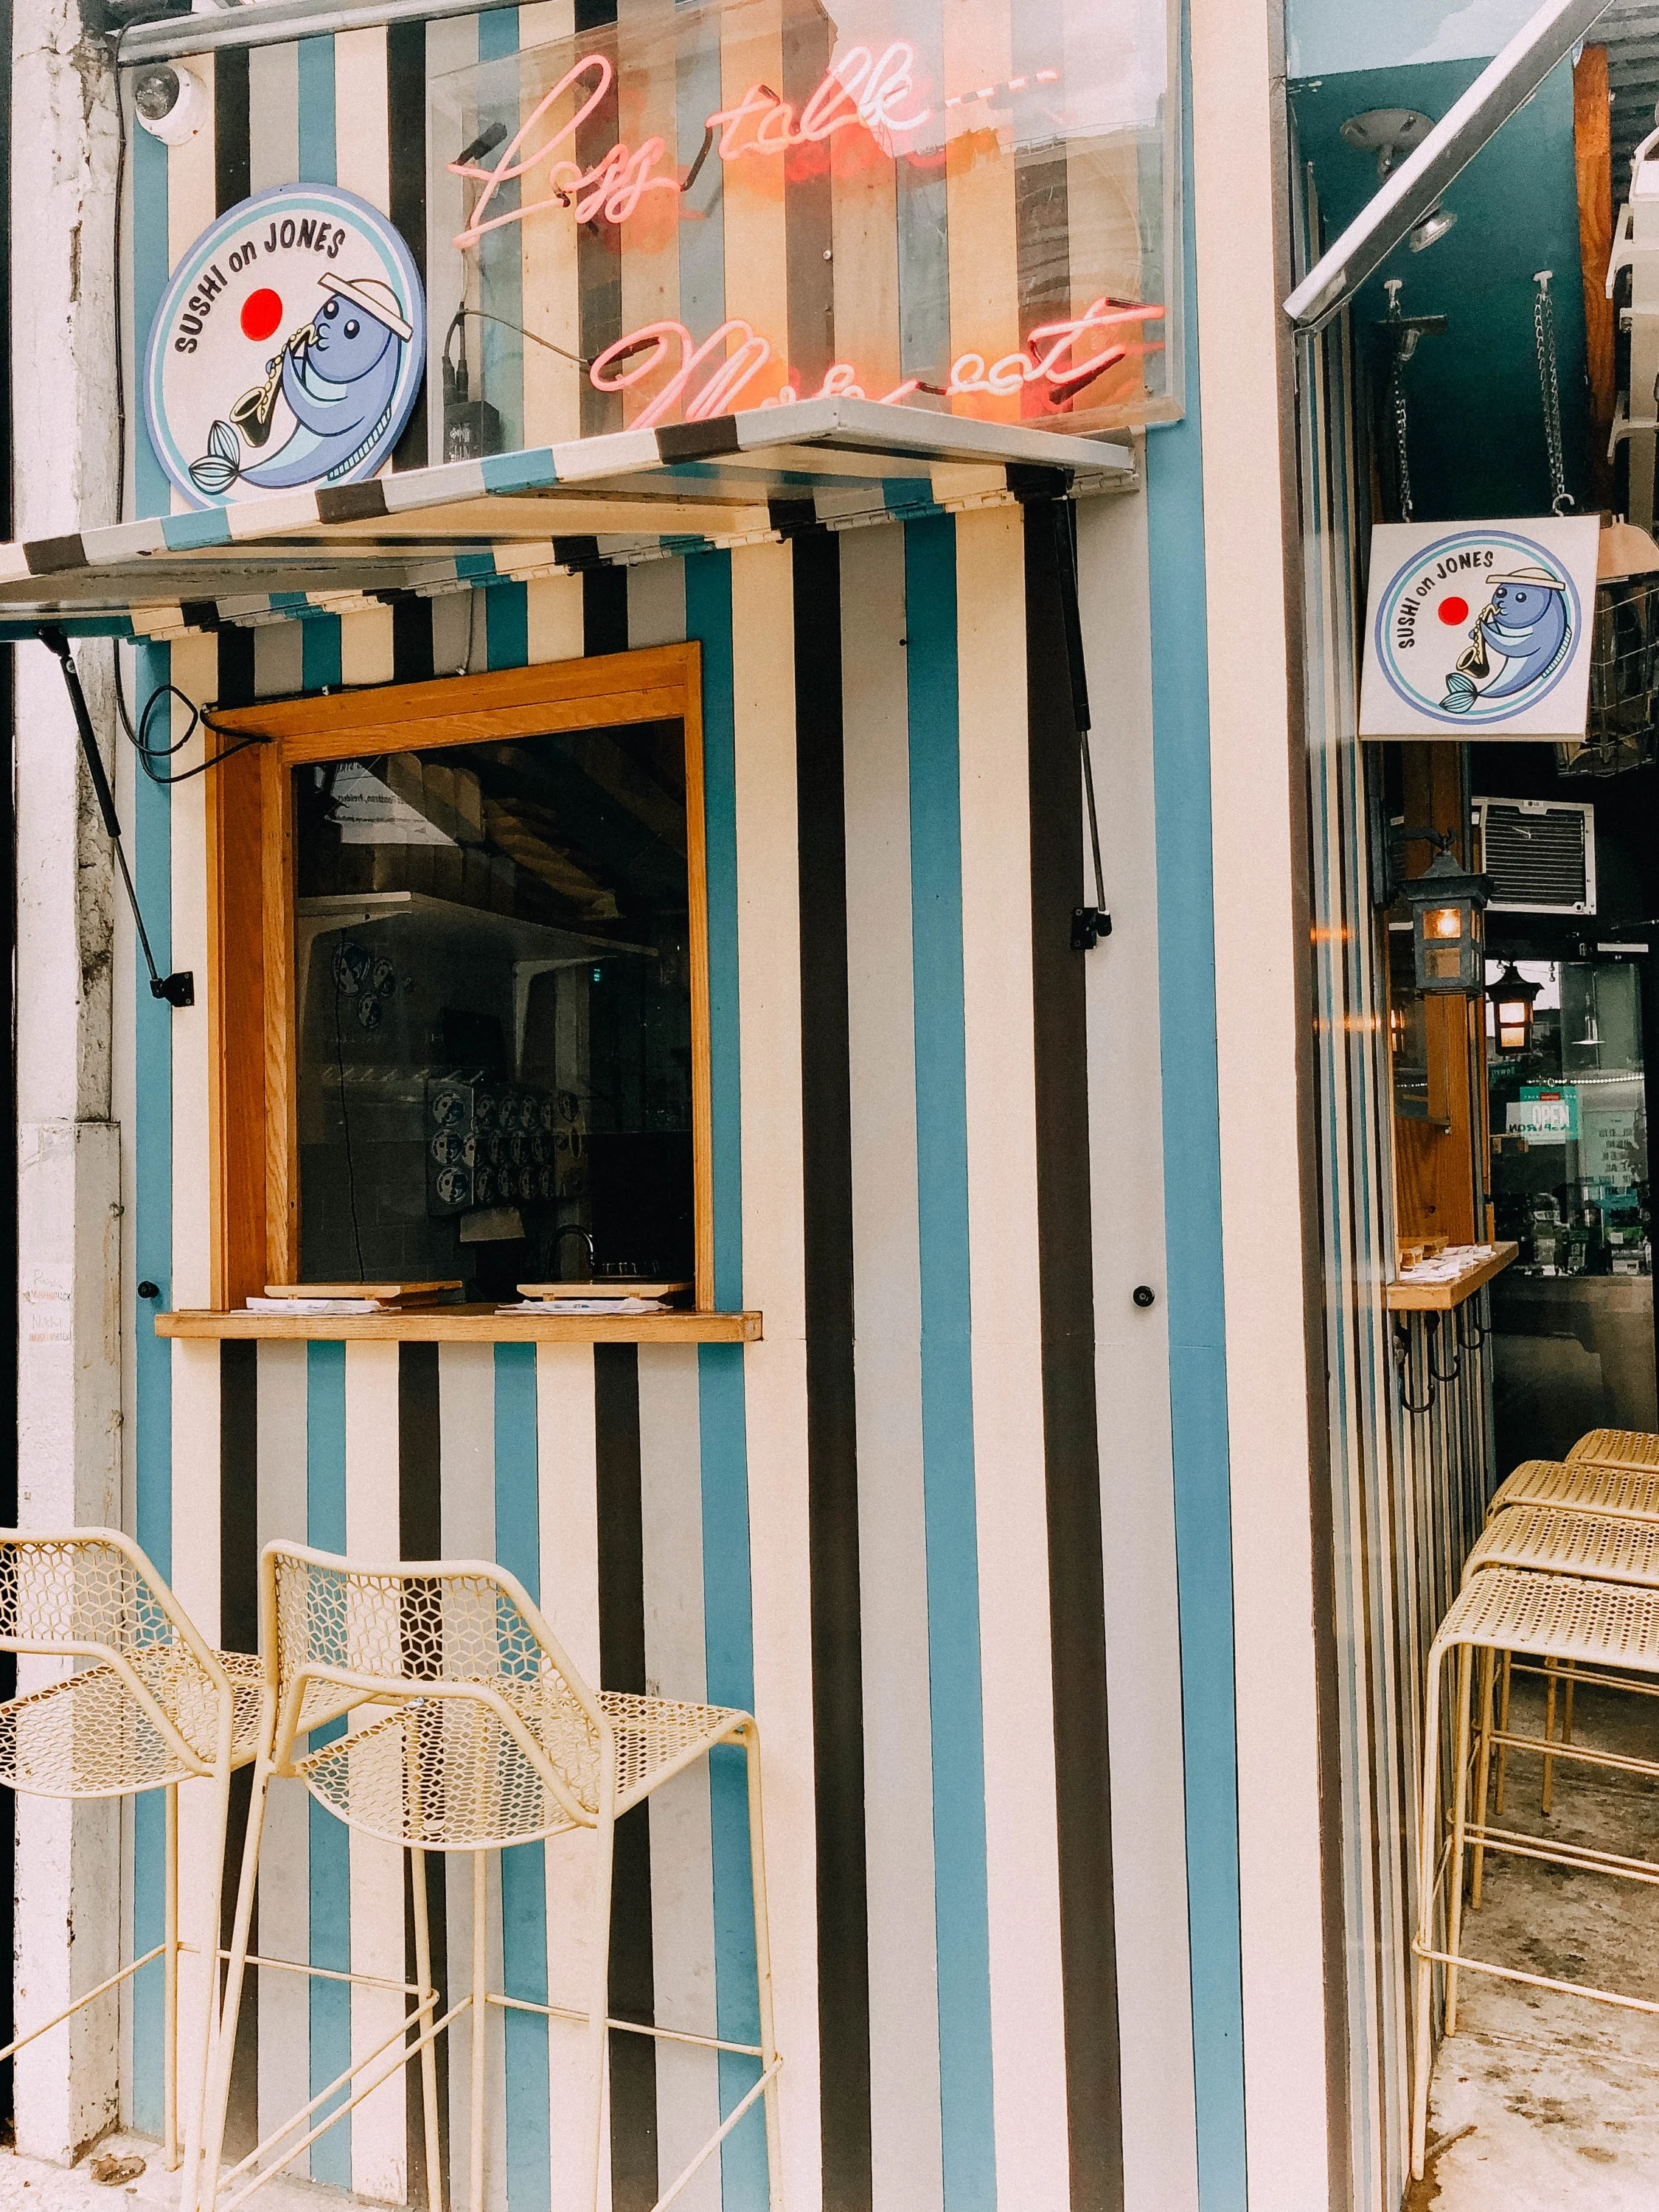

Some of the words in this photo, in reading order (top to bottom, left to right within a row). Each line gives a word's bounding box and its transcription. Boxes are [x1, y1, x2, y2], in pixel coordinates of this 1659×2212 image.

[706, 42, 930, 160] talk
[175, 265, 228, 354] SUSHI
[229, 241, 257, 273] on
[264, 218, 346, 259] JONES
[950, 297, 1165, 395] eat
[1397, 598, 1420, 648] SUSHI
[1416, 577, 1436, 597] on
[1437, 551, 1493, 579] JONES
[1532, 1105, 1570, 1128] OPEN
